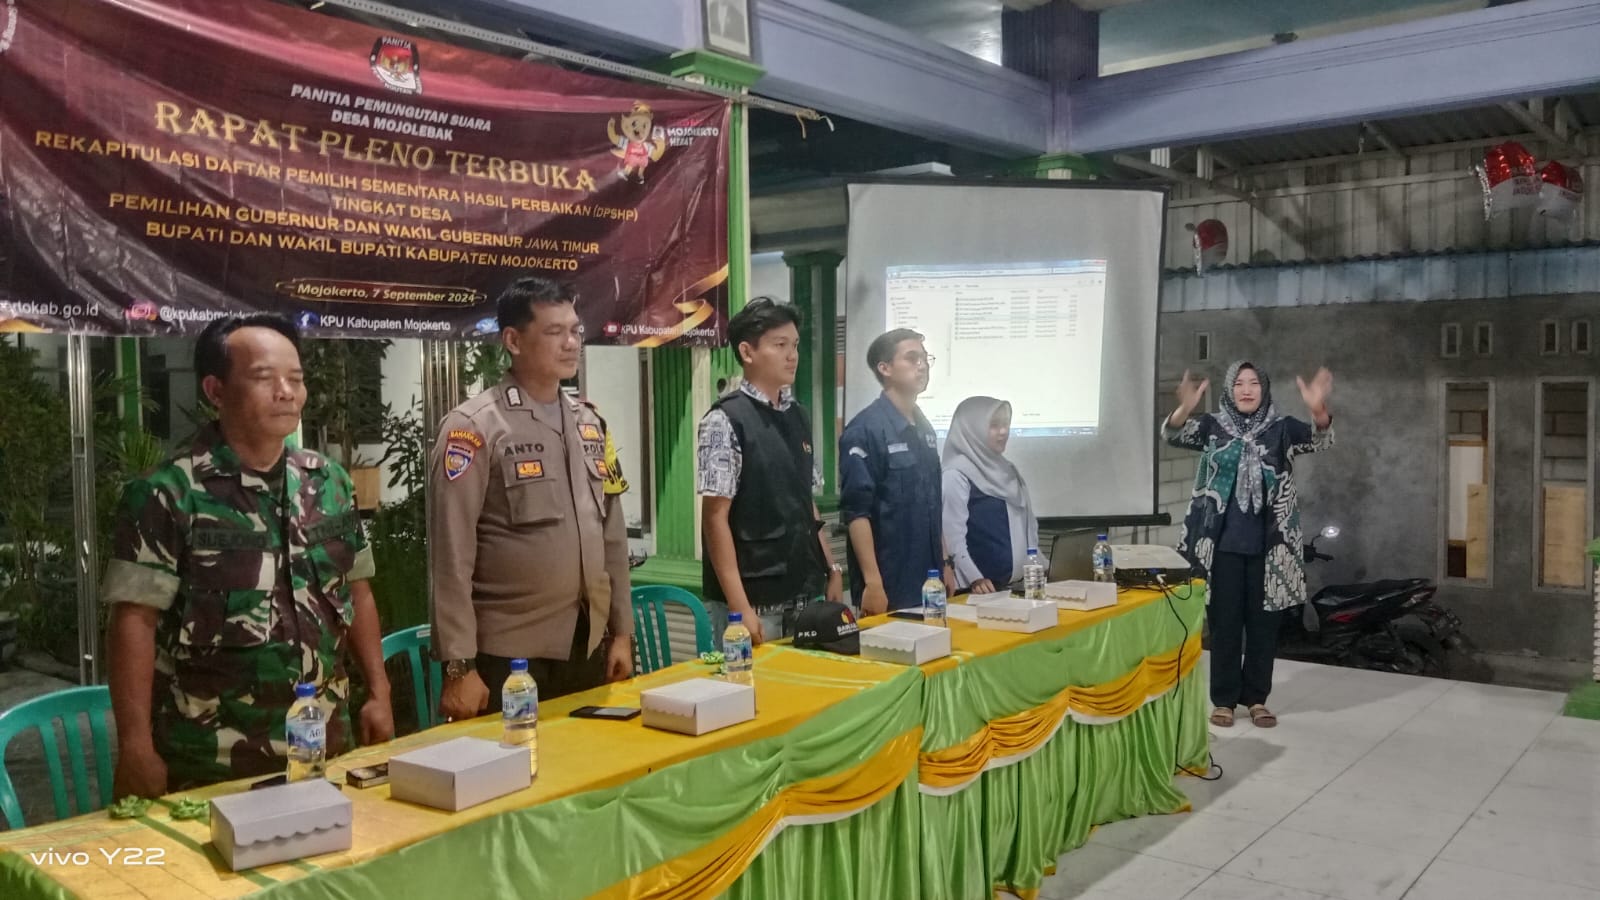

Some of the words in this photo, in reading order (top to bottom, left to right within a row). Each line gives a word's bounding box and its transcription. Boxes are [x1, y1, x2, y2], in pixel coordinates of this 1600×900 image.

[291, 84, 351, 107] PANITIA
[354, 97, 450, 125] PEMUNGUTAN
[449, 114, 492, 132] SUARA
[331, 109, 371, 128] DESA
[373, 116, 454, 142] MOJOLEBAK
[153, 100, 307, 153] RAPAT
[318, 129, 435, 172] PLENO
[446, 149, 599, 193] TERBUKA
[35, 130, 200, 169] REKAPITULASI
[205, 156, 281, 180] DAFTAR
[285, 168, 357, 190] PEMILIH
[361, 178, 461, 203] SEMENTARA
[464, 191, 509, 209] HASIL
[511, 196, 591, 217] PERBAIKAN
[592, 206, 639, 223] (DPSHP)
[109, 193, 231, 220] PEMILIHAN
[235, 207, 340, 232] GUBERNUR
[343, 219, 380, 235] DAN
[384, 223, 437, 241] WAKIL
[440, 228, 523, 248] GUBERNUR
[524, 238, 559, 252] JAWA
[562, 240, 600, 255] TIMUR
[333, 196, 406, 218] TINGKAT
[410, 206, 453, 223] DESA
[146, 221, 224, 243] BUPATI
[230, 230, 273, 248] DAN
[277, 233, 337, 254] WAKIL
[340, 240, 401, 259] BUPATI
[405, 245, 498, 267] KABUPATEN
[500, 255, 579, 272] MOJOKERTO
[297, 283, 369, 299] Mojokerto,
[372, 288, 380, 298] 7
[383, 288, 445, 303] September
[447, 291, 476, 304] 2024
[320, 315, 345, 328] KPU
[346, 316, 403, 332] Kabupaten
[404, 318, 452, 333] Mojokerto
[621, 324, 638, 335] KPU
[504, 443, 545, 457] ANTO
